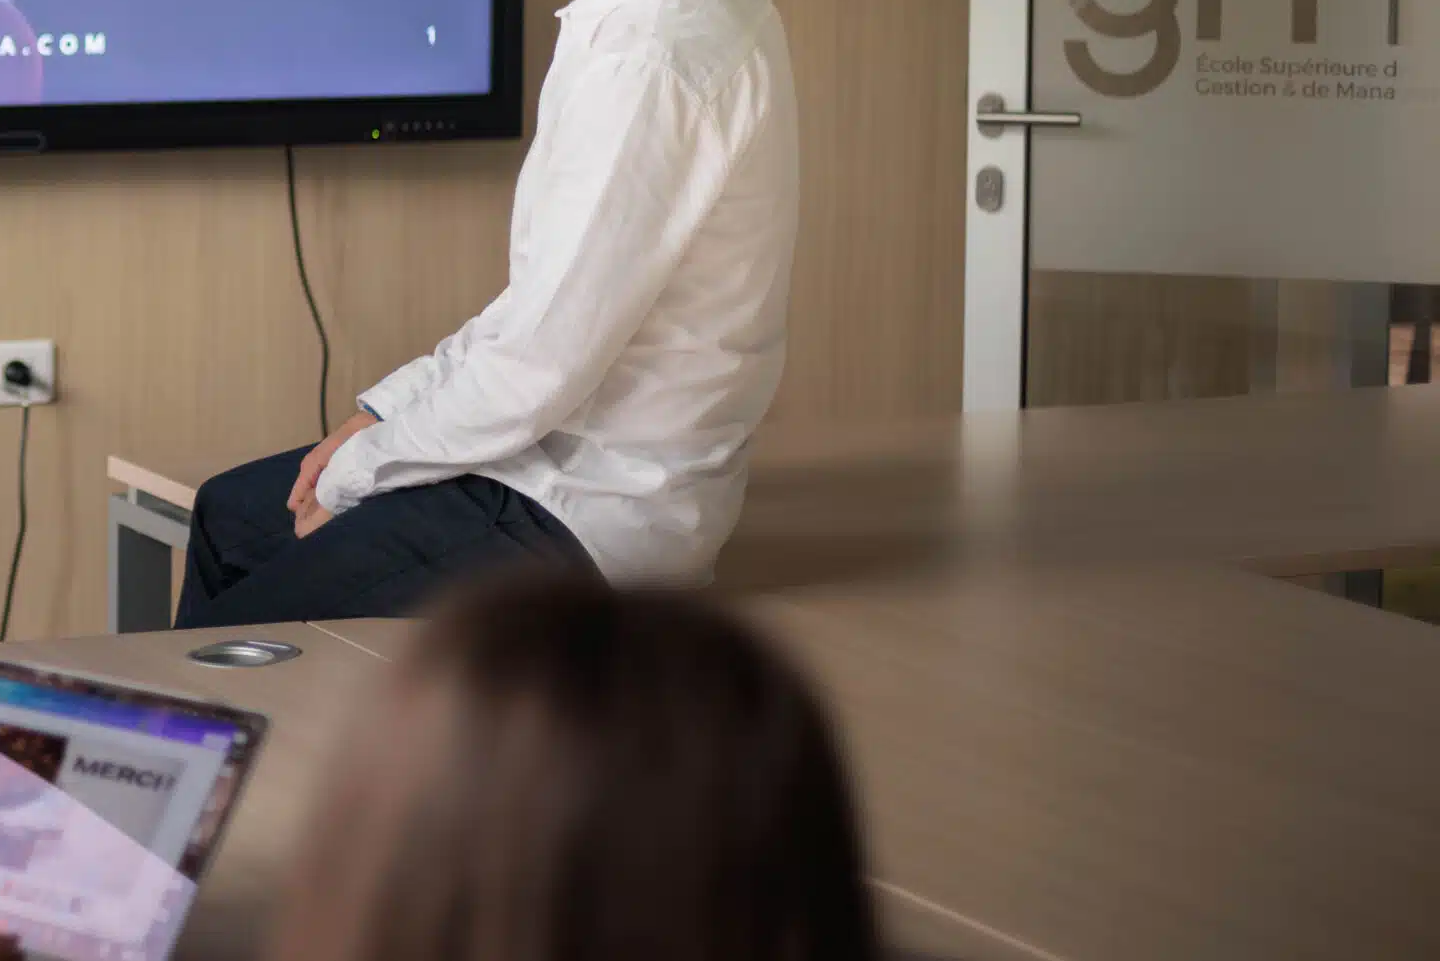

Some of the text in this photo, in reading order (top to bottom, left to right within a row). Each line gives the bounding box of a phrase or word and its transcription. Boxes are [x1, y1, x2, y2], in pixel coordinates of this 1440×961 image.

[426, 24, 437, 46] 1
[1195, 52, 1398, 78] École Supérieure d
[1195, 78, 1276, 97] Gestion
[1301, 81, 1330, 99] de
[1336, 82, 1396, 101] Mana
